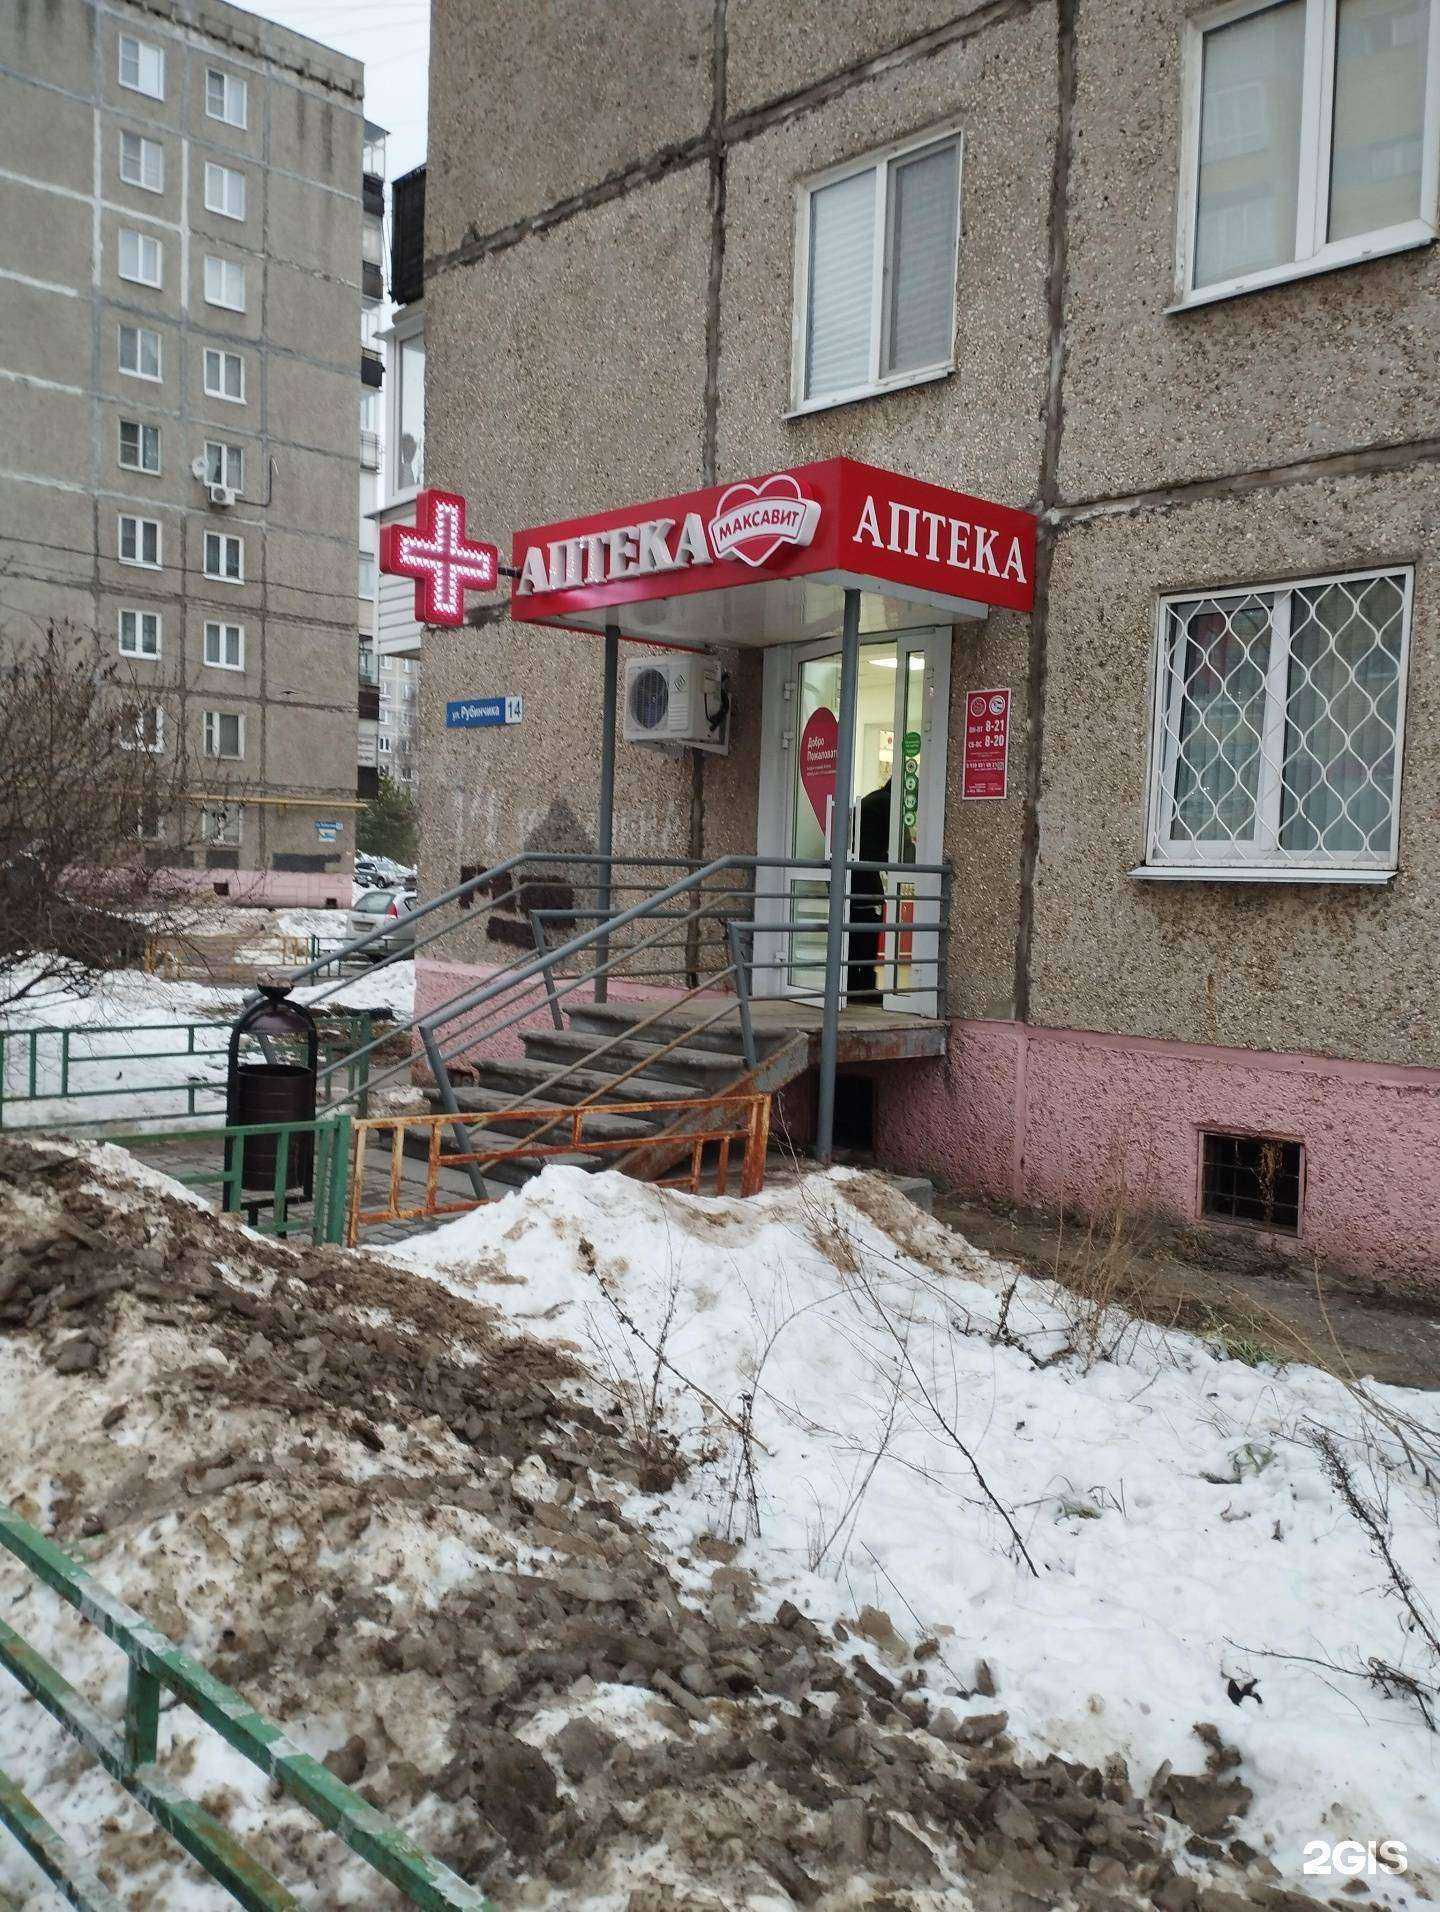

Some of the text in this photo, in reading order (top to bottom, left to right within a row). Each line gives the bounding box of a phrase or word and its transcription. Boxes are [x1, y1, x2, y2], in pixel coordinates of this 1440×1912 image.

[718, 508, 800, 540] МАКСАВИТ
[852, 495, 1028, 585] АПТЕКА
[516, 512, 713, 597] АПТЕКА
[461, 704, 500, 720] Рубинчика
[508, 701, 521, 718] 14
[985, 720, 1004, 732] 8-21
[808, 736, 825, 750] Добро
[985, 734, 1004, 748] 8-20
